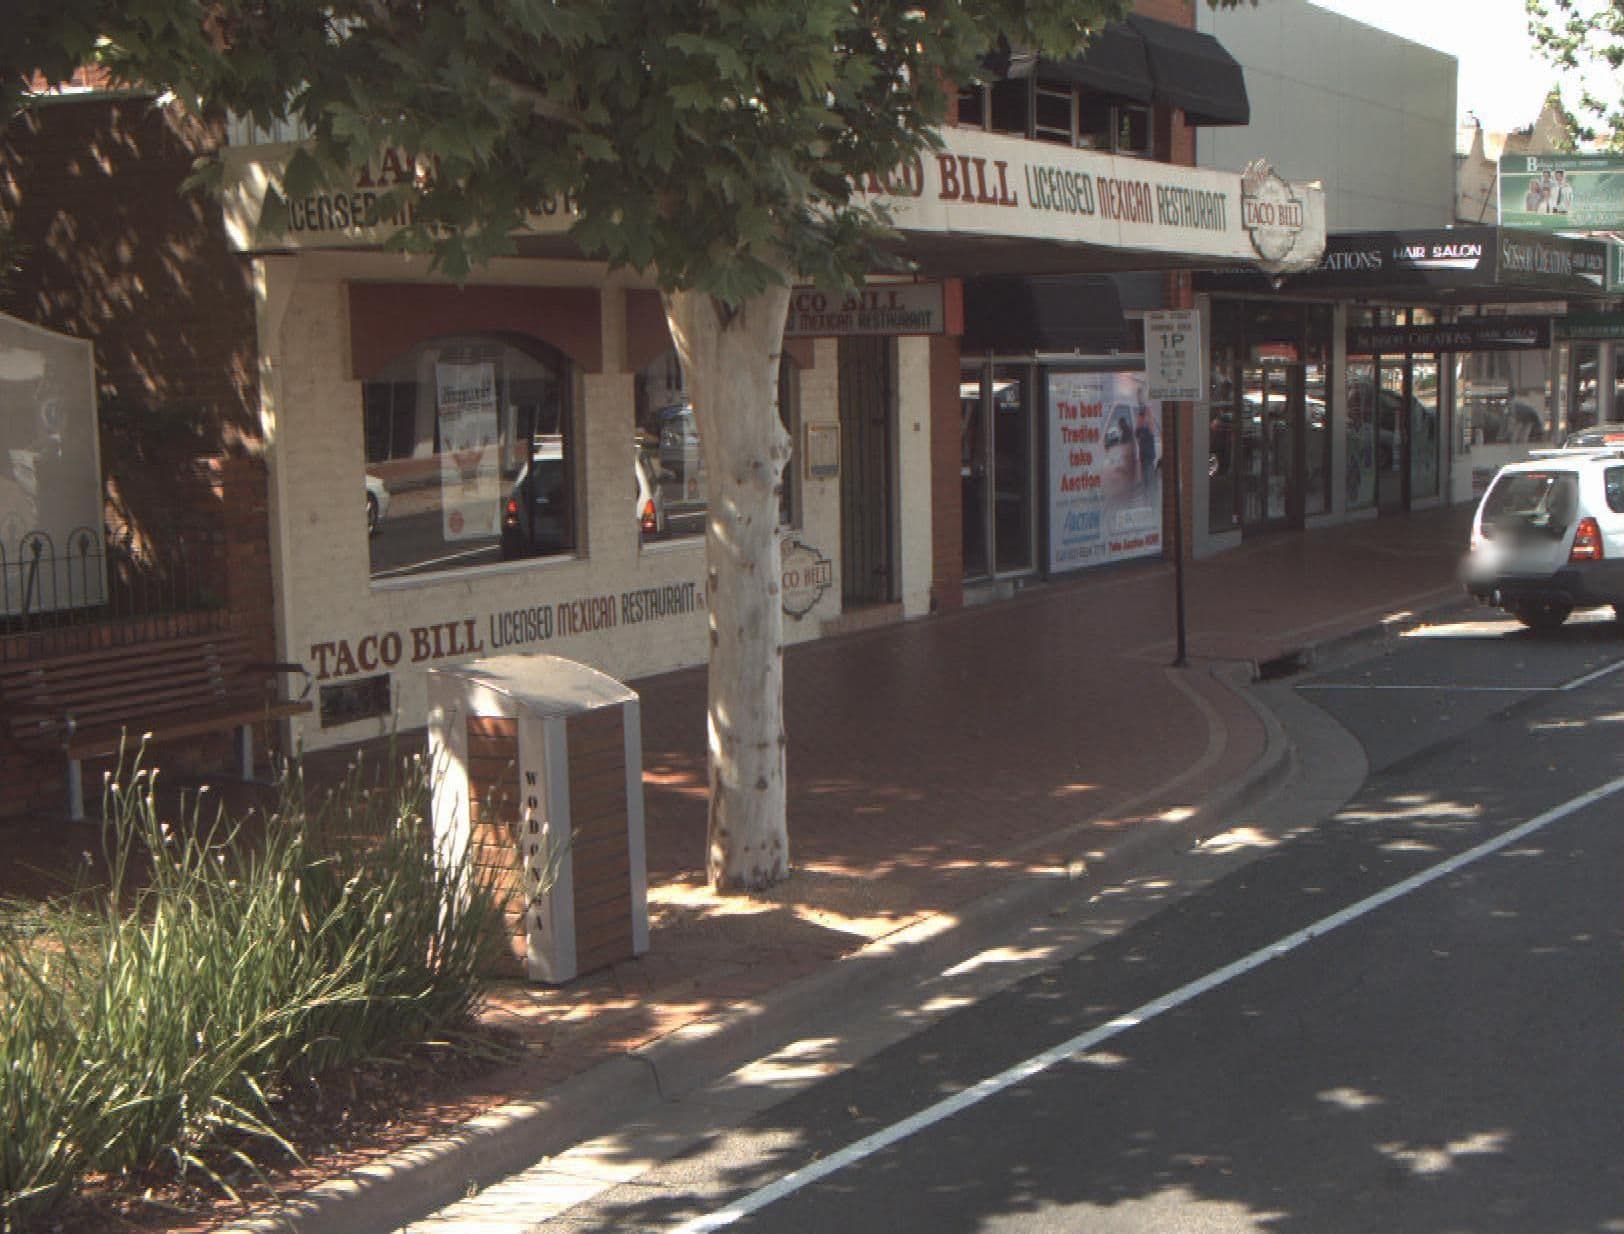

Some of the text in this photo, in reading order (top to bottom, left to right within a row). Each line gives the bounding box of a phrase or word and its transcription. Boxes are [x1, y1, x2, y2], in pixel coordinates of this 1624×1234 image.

[935, 152, 1018, 208] BILL
[1024, 163, 1227, 232] LICENSED MEXICAN RESTAURANT
[1247, 201, 1301, 228] TACO BILL
[1321, 243, 1483, 271] ATIONS HAIR SALON
[1160, 333, 1184, 348] 1P
[310, 582, 696, 681] TACO BILL LICENSED MEXICAN RESTAURANT
